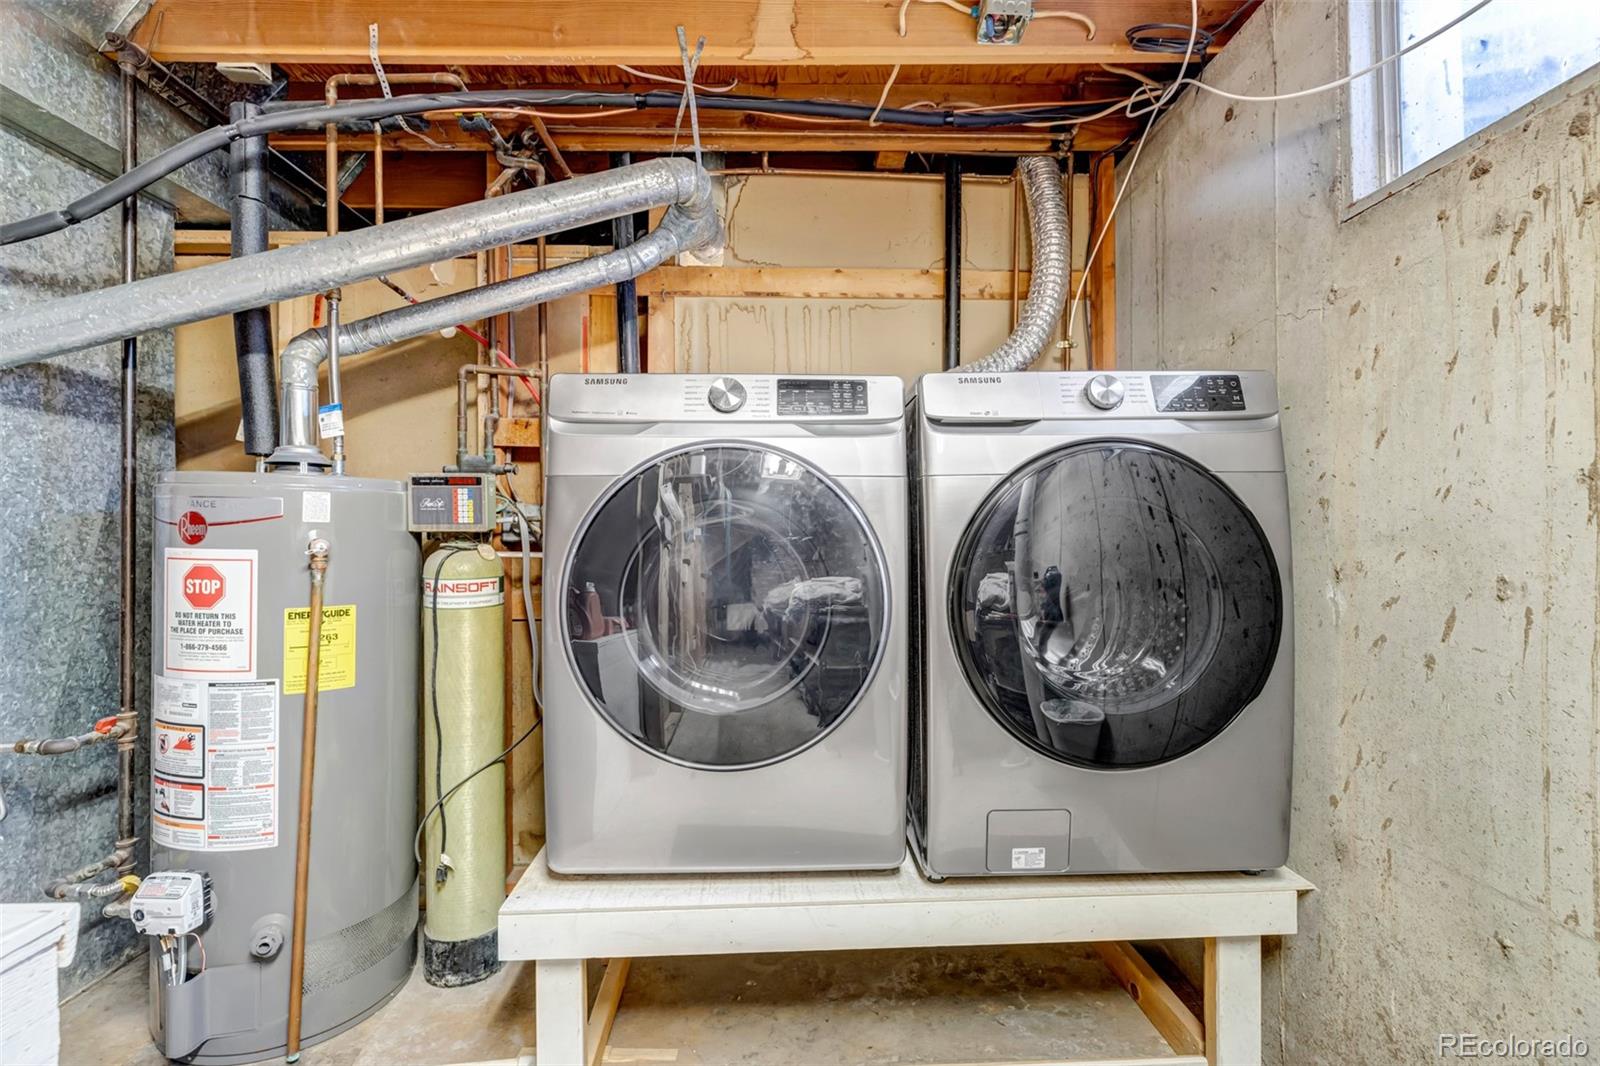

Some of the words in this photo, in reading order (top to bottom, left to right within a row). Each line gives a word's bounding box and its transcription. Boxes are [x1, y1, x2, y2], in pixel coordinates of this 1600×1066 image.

[584, 377, 628, 385] SAMSUNG
[186, 578, 221, 595] STOP
[425, 581, 497, 593] RAINSOFT
[174, 611, 182, 619] DO
[182, 611, 193, 619] NOT
[194, 612, 219, 620] RETURN
[221, 612, 237, 620] THIS
[287, 608, 351, 621] ENERGUIDE
[177, 619, 196, 627] WATER
[223, 620, 232, 628] TO
[170, 626, 179, 634] THE
[179, 626, 197, 635] PLACE
[197, 627, 206, 635] OF
